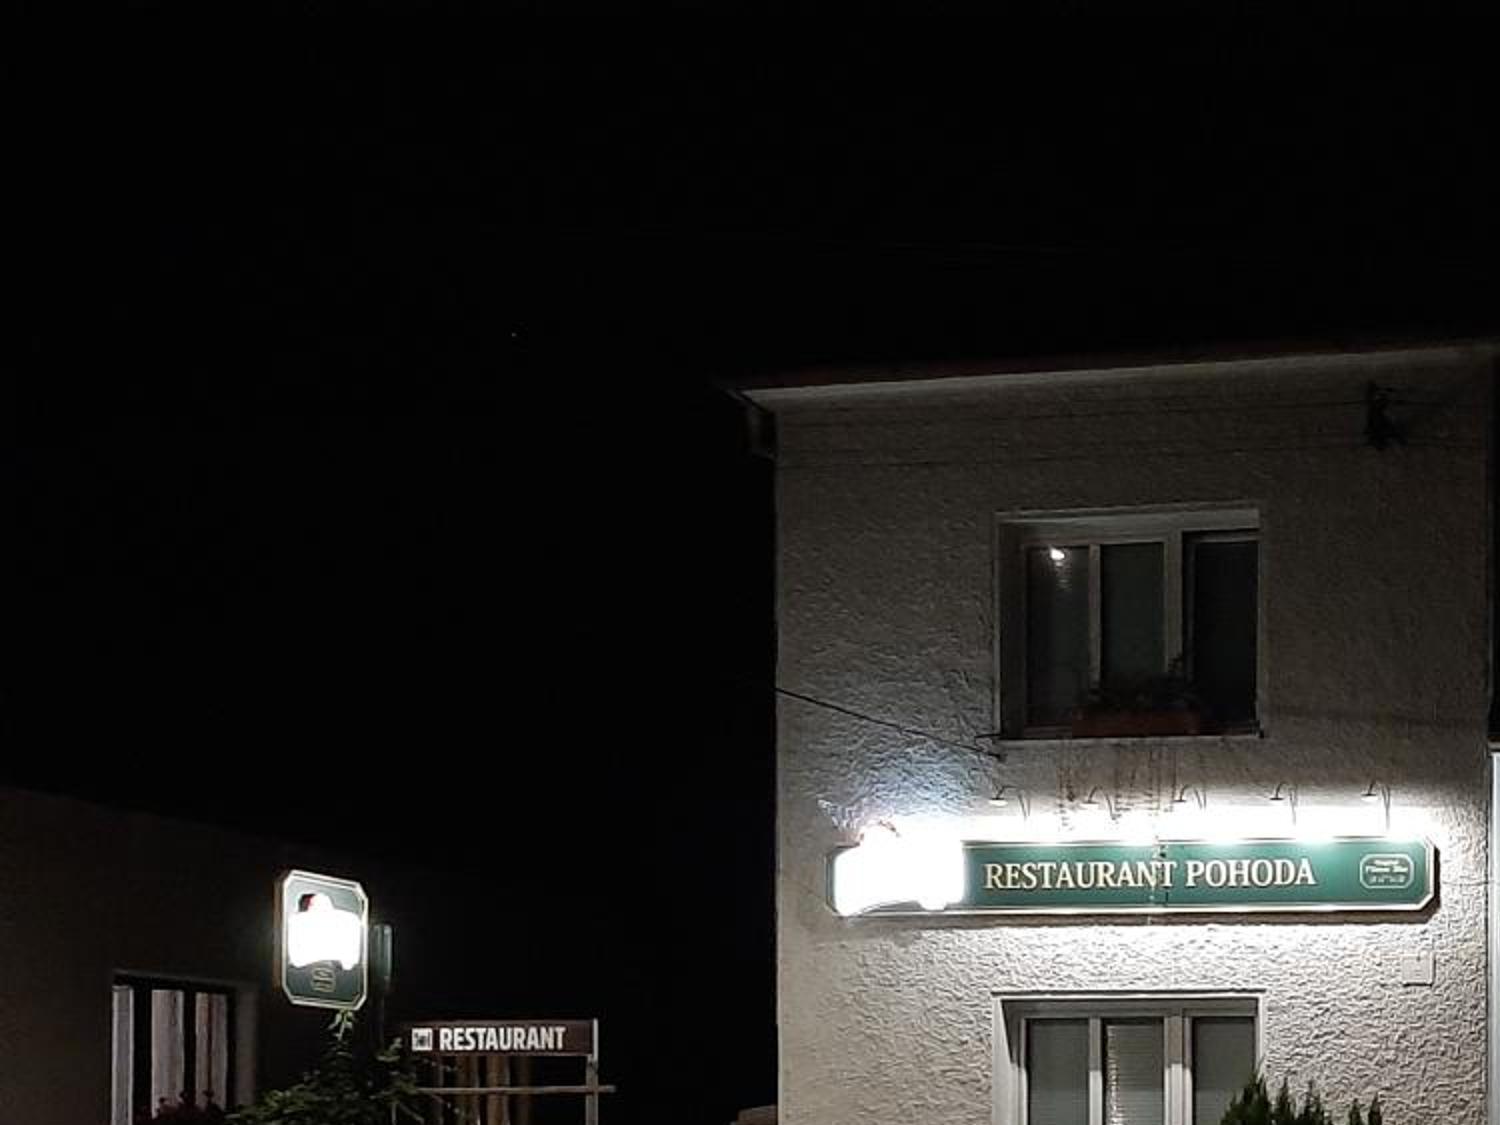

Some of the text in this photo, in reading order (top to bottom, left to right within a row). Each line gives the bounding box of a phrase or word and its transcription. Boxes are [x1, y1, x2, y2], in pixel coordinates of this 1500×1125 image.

[983, 858, 1316, 889] RESTAURANT POHODA
[439, 1026, 567, 1050] RESTAURANT
